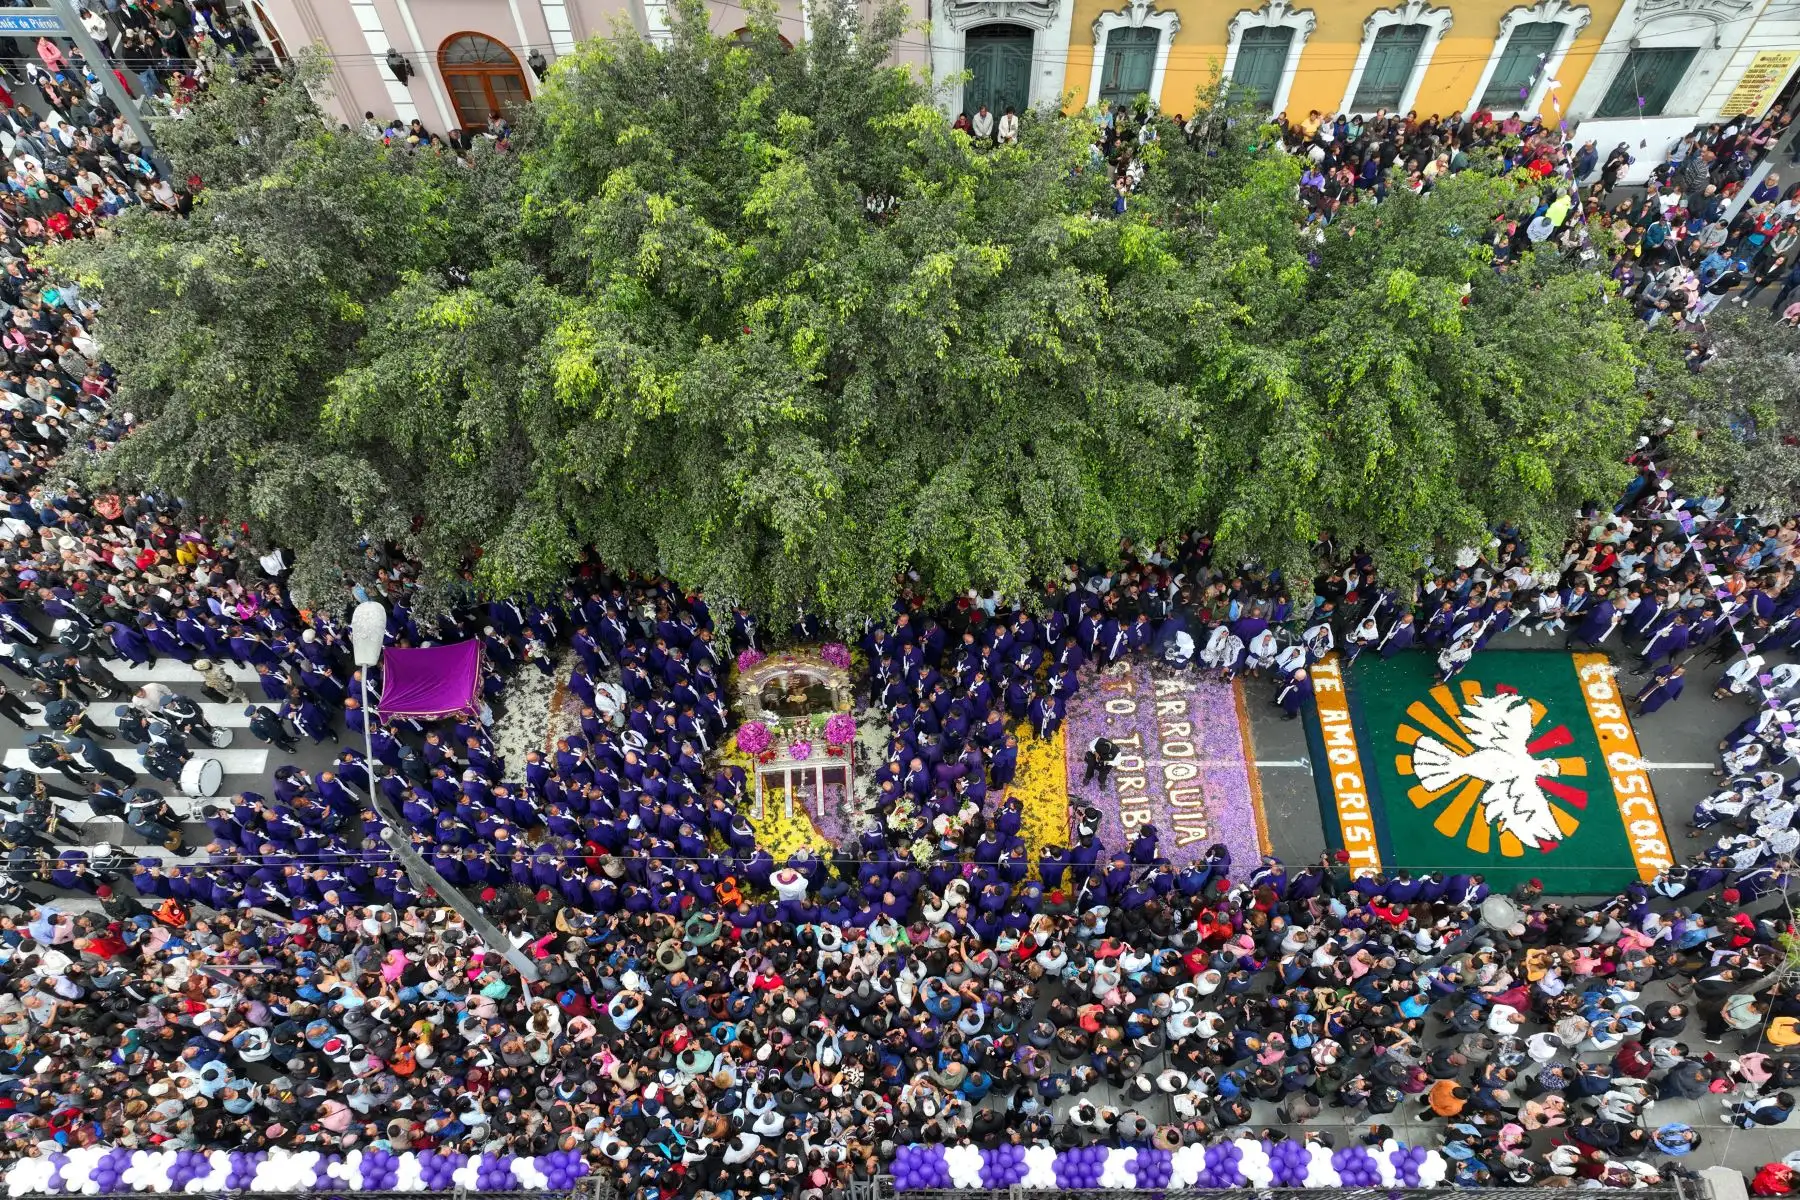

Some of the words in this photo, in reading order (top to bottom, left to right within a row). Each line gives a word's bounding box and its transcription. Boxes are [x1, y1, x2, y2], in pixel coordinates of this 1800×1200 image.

[0, 18, 18, 28] olás
[19, 18, 31, 28] de
[1311, 658, 1342, 692] TE
[1112, 732, 1158, 858] TORIB
[1154, 678, 1207, 846] ARROQUIA
